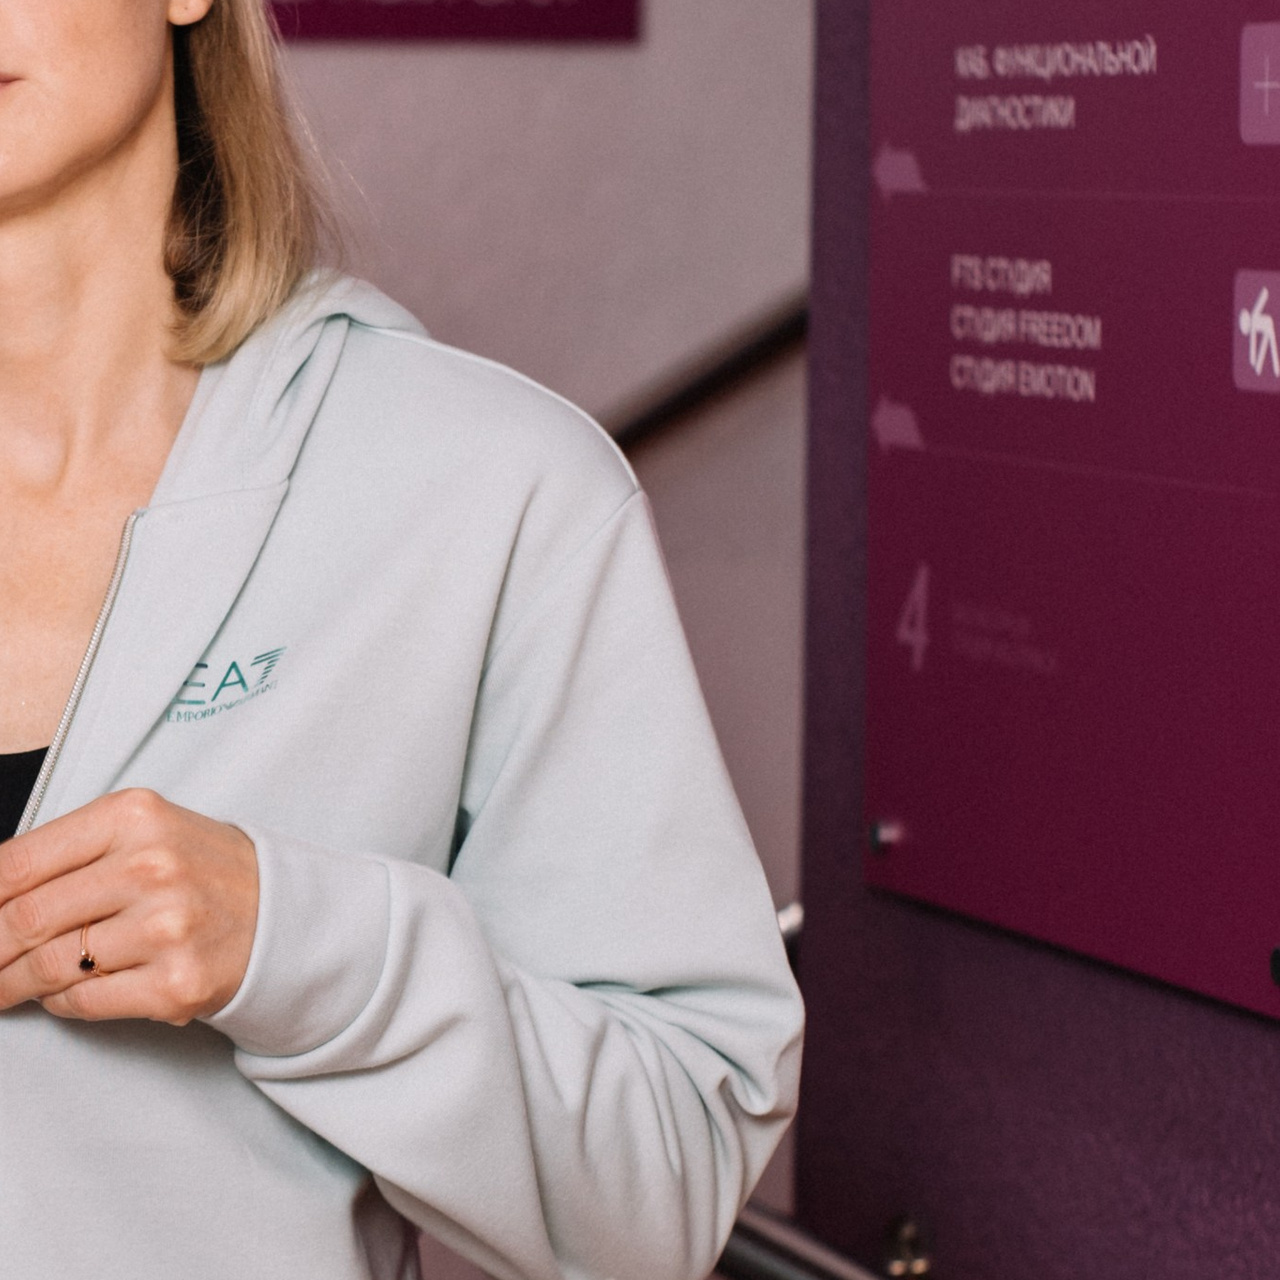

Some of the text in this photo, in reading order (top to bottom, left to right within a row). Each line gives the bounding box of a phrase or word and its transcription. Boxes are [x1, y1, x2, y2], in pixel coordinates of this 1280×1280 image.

[1019, 309, 1102, 350] FREEDOM
[1019, 360, 1096, 403] EMOTION
[896, 561, 930, 672] 4
